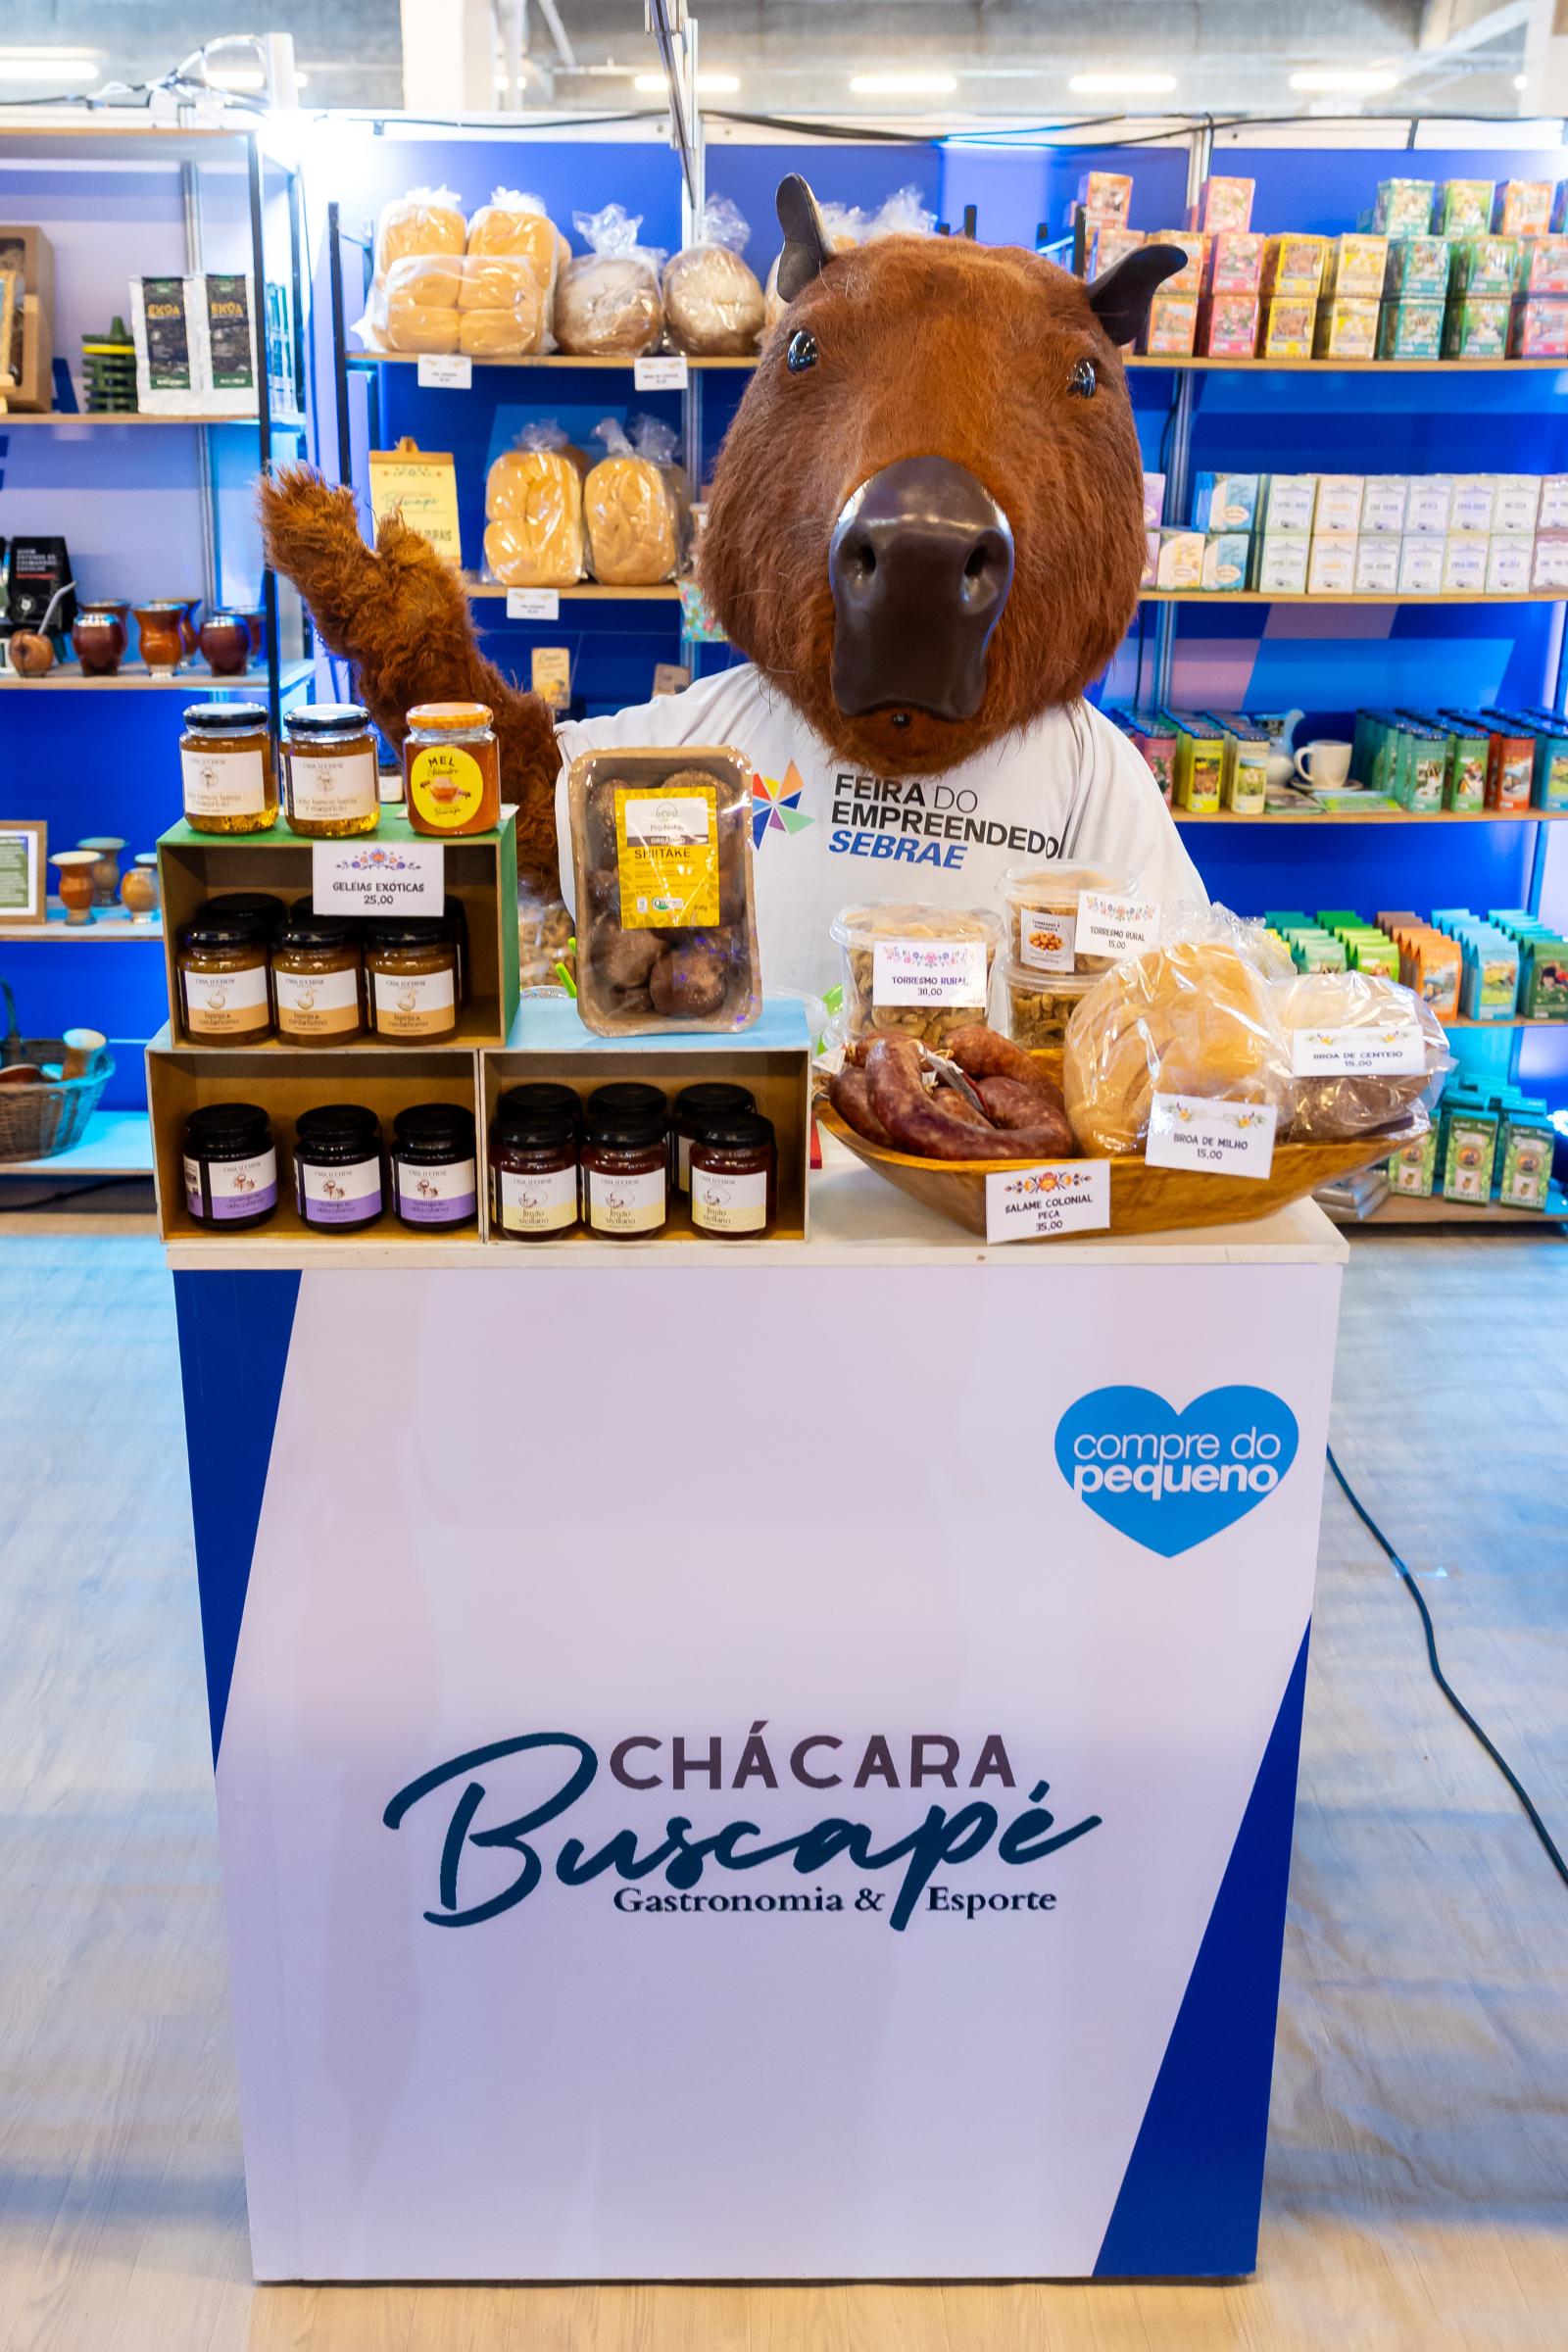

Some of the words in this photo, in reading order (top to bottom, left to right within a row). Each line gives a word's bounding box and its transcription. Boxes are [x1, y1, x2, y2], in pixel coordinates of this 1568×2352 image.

[428, 755, 455, 767] MEL
[834, 773, 926, 808] FEIRA
[934, 785, 978, 813] DO
[831, 800, 1065, 859] EMPREENDEDO
[828, 829, 968, 870] SEBRAE
[364, 895, 394, 906] 25,00
[1090, 925, 1124, 938] TORRESMO
[1125, 931, 1146, 942] RURAL
[1108, 939, 1126, 950] 15,00
[892, 976, 938, 986] TORRESMO
[917, 988, 943, 997] 38,00
[1313, 1052, 1340, 1060] BROA
[1359, 1051, 1403, 1059] CENTEIO
[1173, 1133, 1199, 1147] BROA
[1201, 1136, 1214, 1148] DE
[1217, 1137, 1249, 1152] MILHO
[1197, 1148, 1223, 1160] 15,00
[1004, 1200, 1042, 1214] SALAME
[1046, 1194, 1093, 1209] COLONIAL
[1035, 1219, 1063, 1232] 35,00
[1073, 1433, 1220, 1465] compre
[1230, 1426, 1282, 1460] do
[1073, 1463, 1279, 1501] pequeno
[609, 1720, 1017, 1791] CHÁCARA
[382, 1731, 1103, 1933] Buscapé
[613, 1886, 844, 1913] Gastronomia
[854, 1886, 886, 1913] &
[926, 1886, 1057, 1921] Esporte
